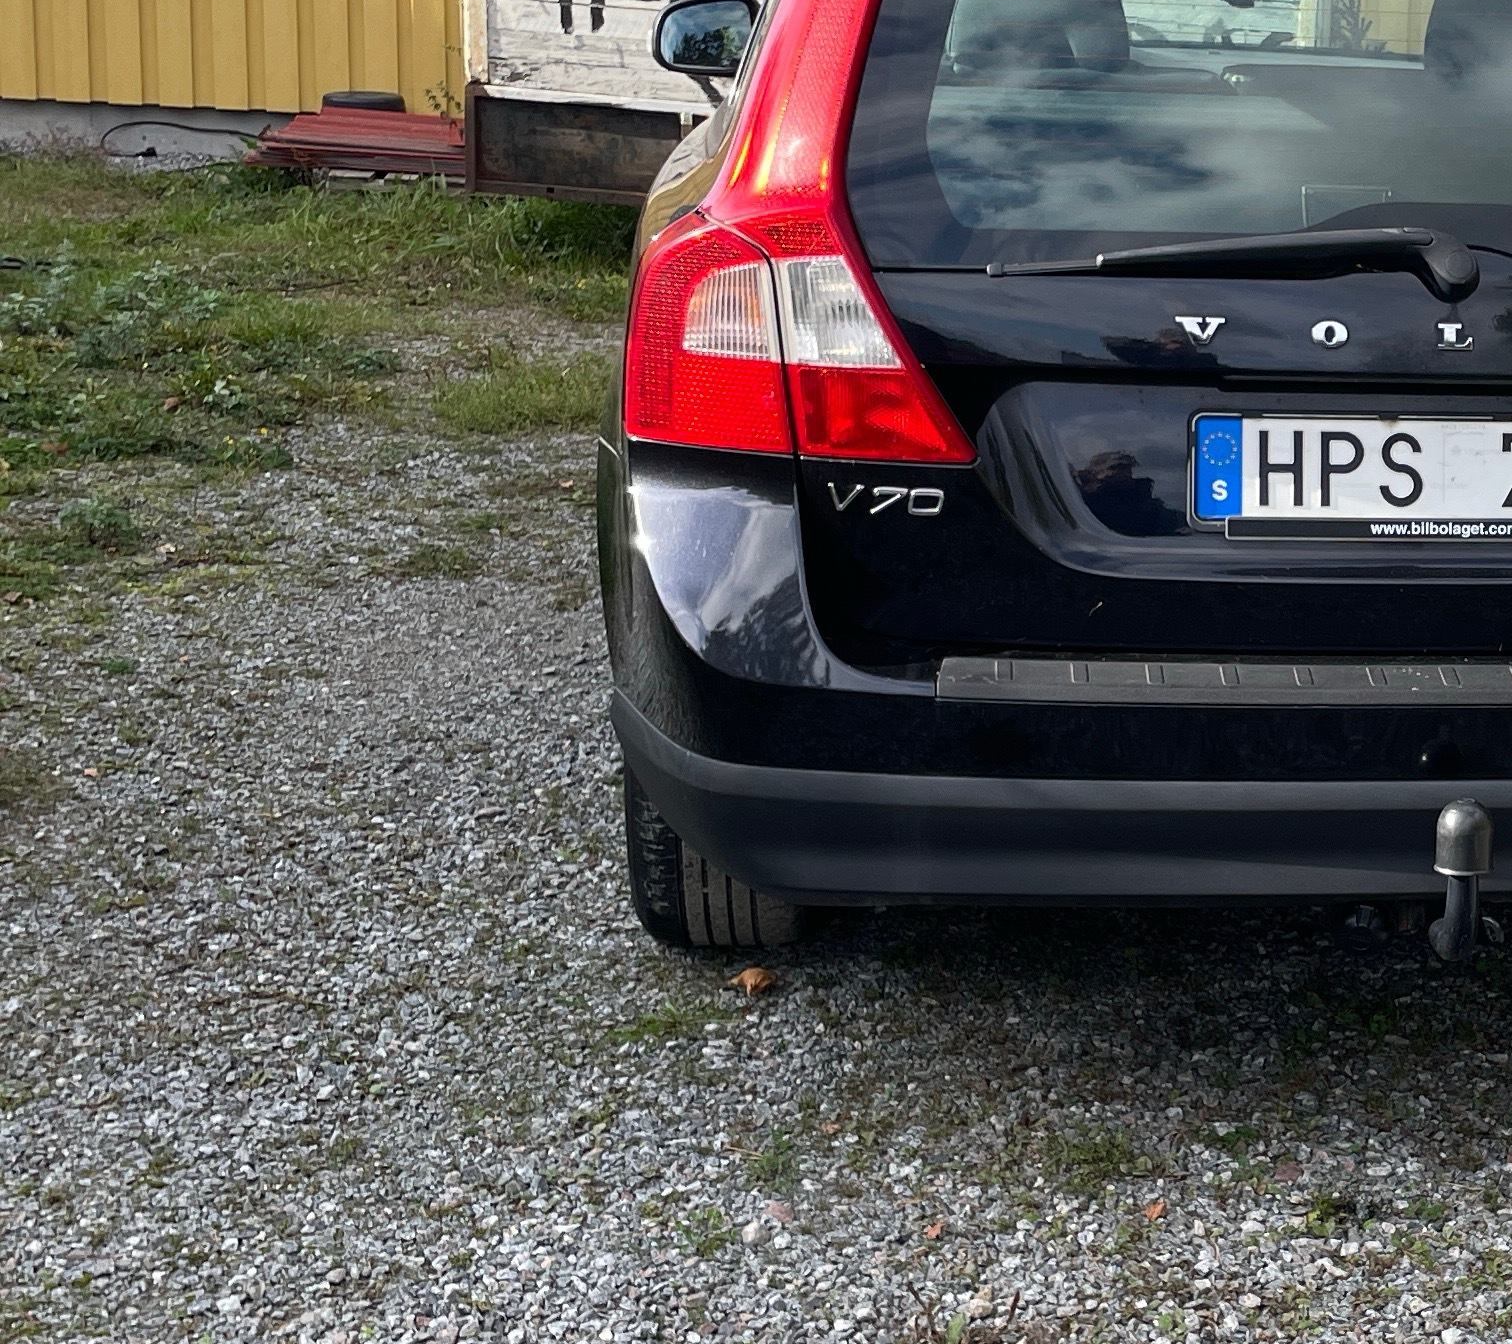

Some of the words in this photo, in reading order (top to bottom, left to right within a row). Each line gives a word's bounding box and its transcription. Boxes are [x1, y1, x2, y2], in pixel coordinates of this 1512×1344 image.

[1257, 430, 1424, 508] HPS
[827, 482, 946, 517] V70
[1211, 479, 1229, 502] S
